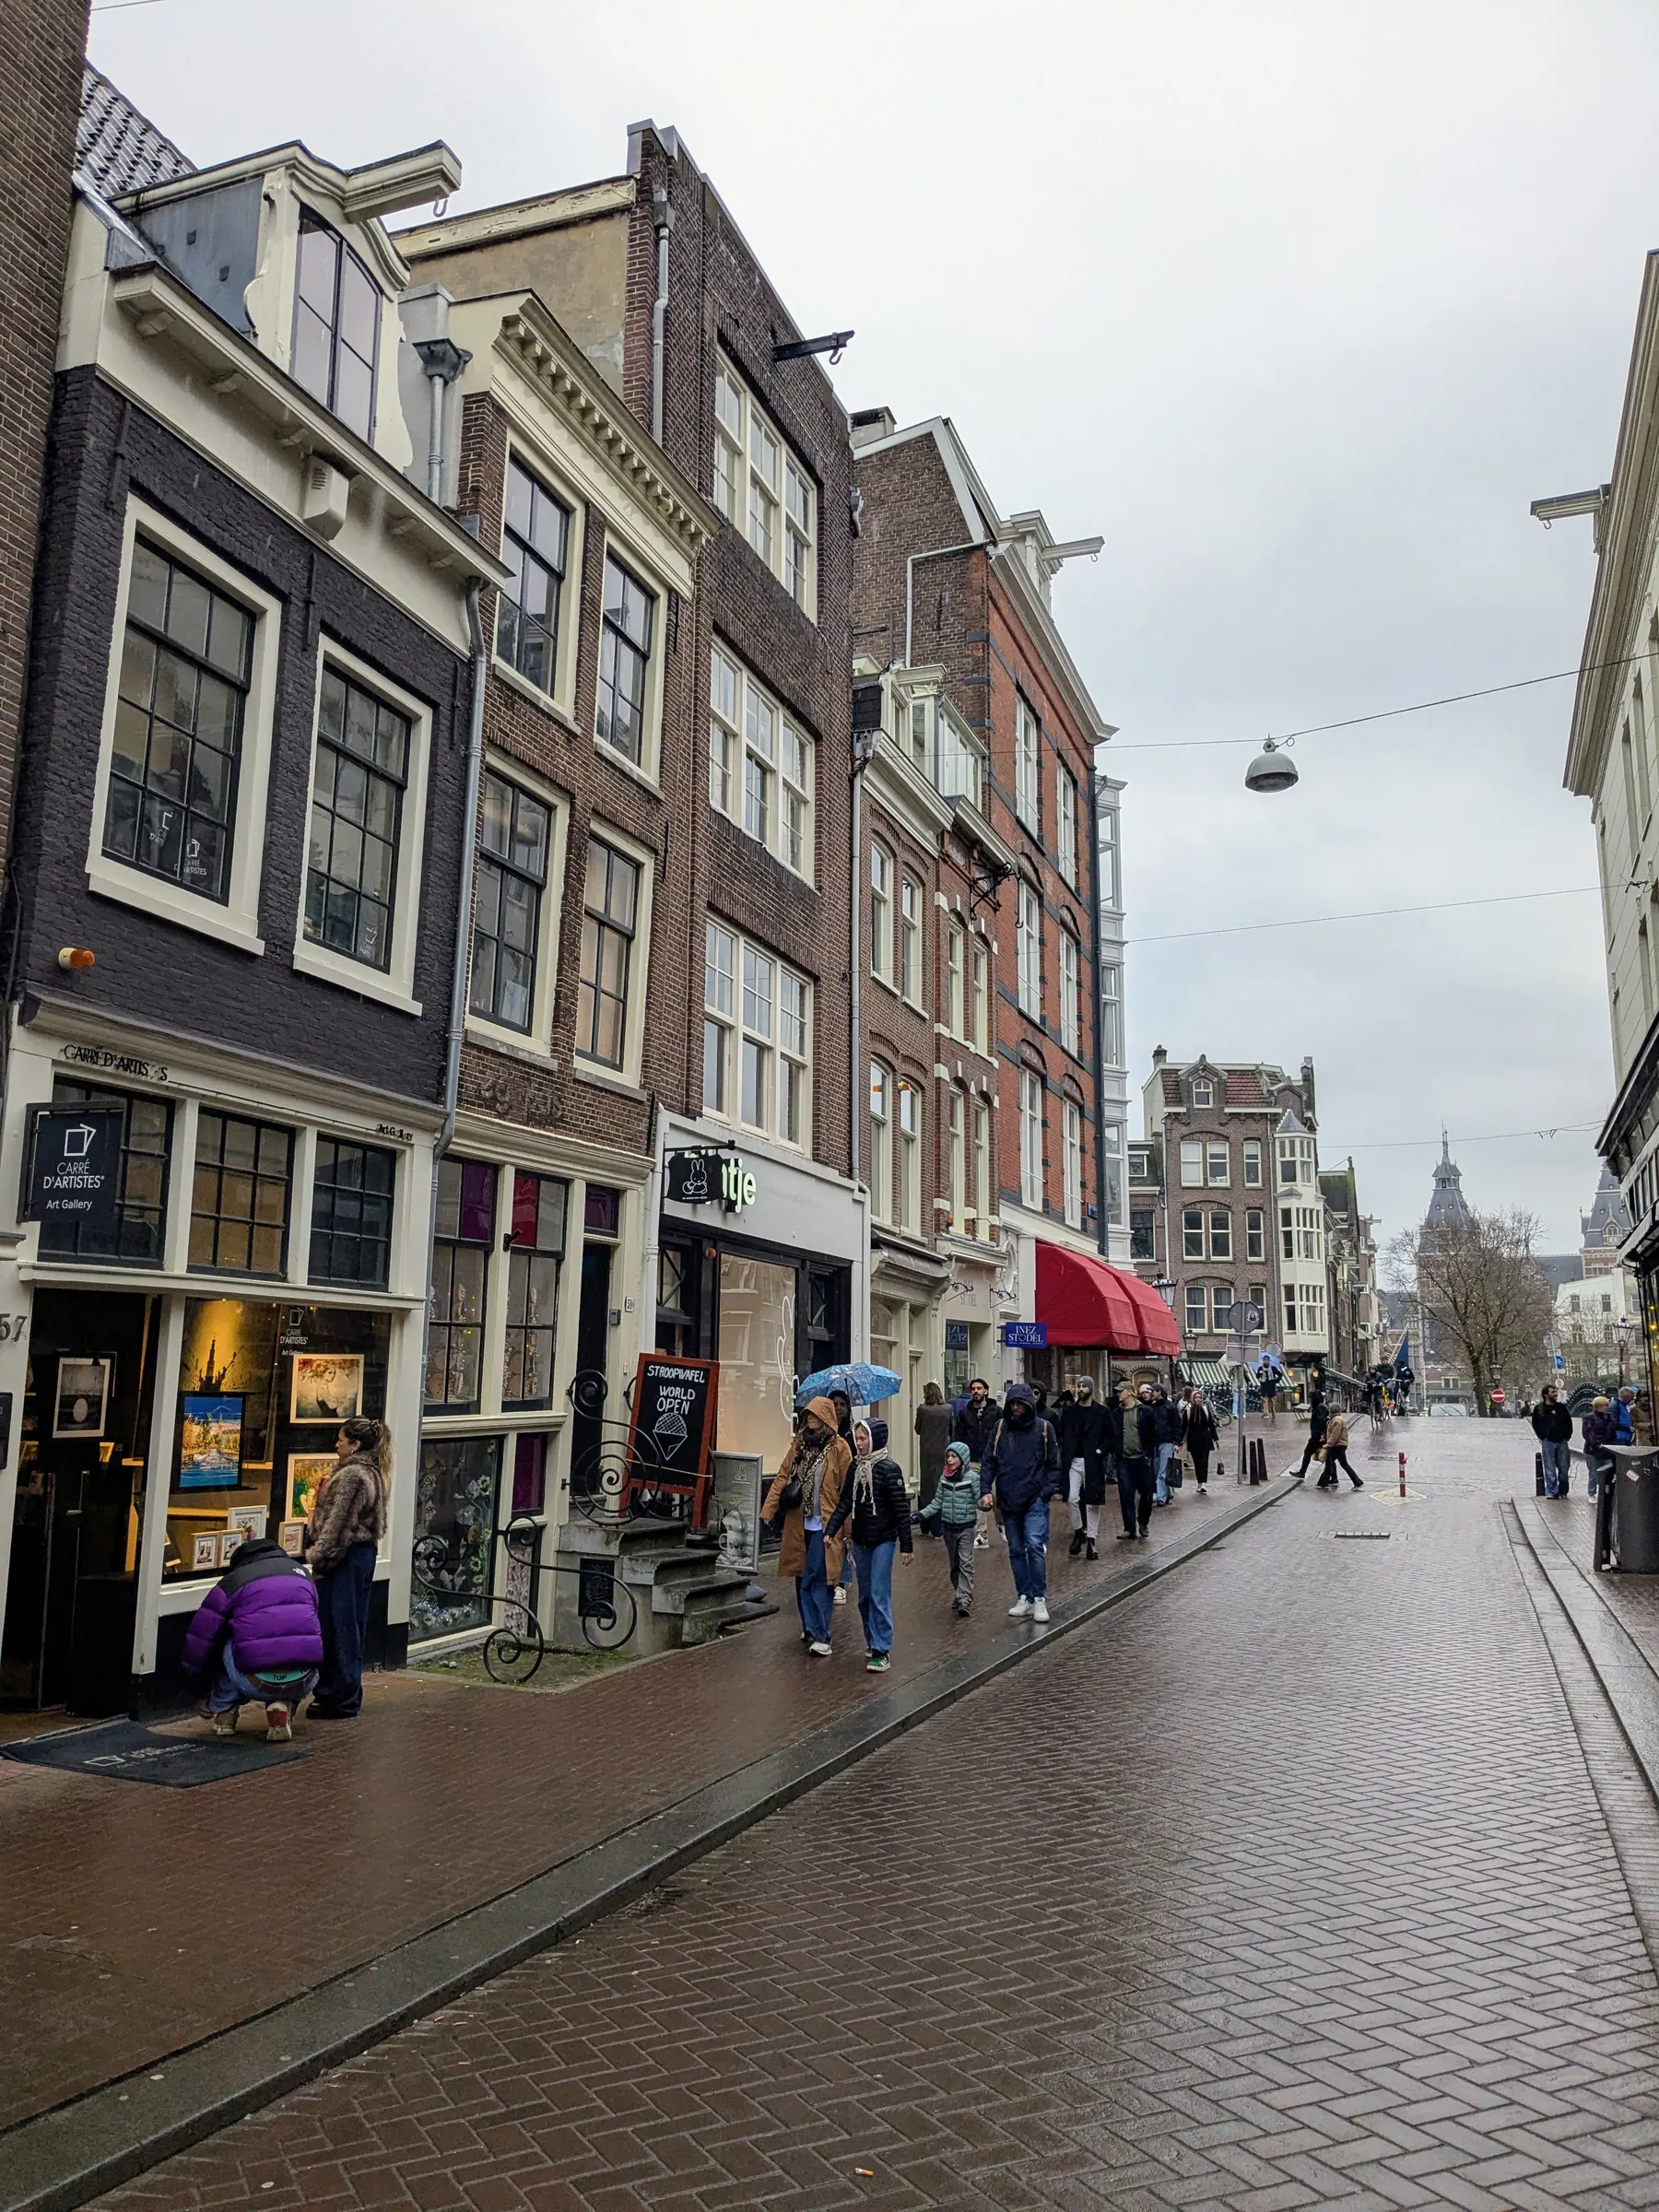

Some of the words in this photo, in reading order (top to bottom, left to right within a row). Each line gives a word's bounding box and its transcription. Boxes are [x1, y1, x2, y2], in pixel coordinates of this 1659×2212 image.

[103, 1053, 168, 1082] D'ARTISS
[390, 1126, 414, 1141] Gllry
[57, 1159, 90, 1175] CARRÉ
[46, 1199, 60, 1209] Art
[61, 1199, 92, 1211] Gallery
[1016, 1325, 1037, 1335] INEZ
[1008, 1333, 1043, 1343] STODEL
[647, 1365, 705, 1383] STROOPWAFEL
[659, 1385, 696, 1400] WORLD
[656, 1397, 690, 1415] OPEN
